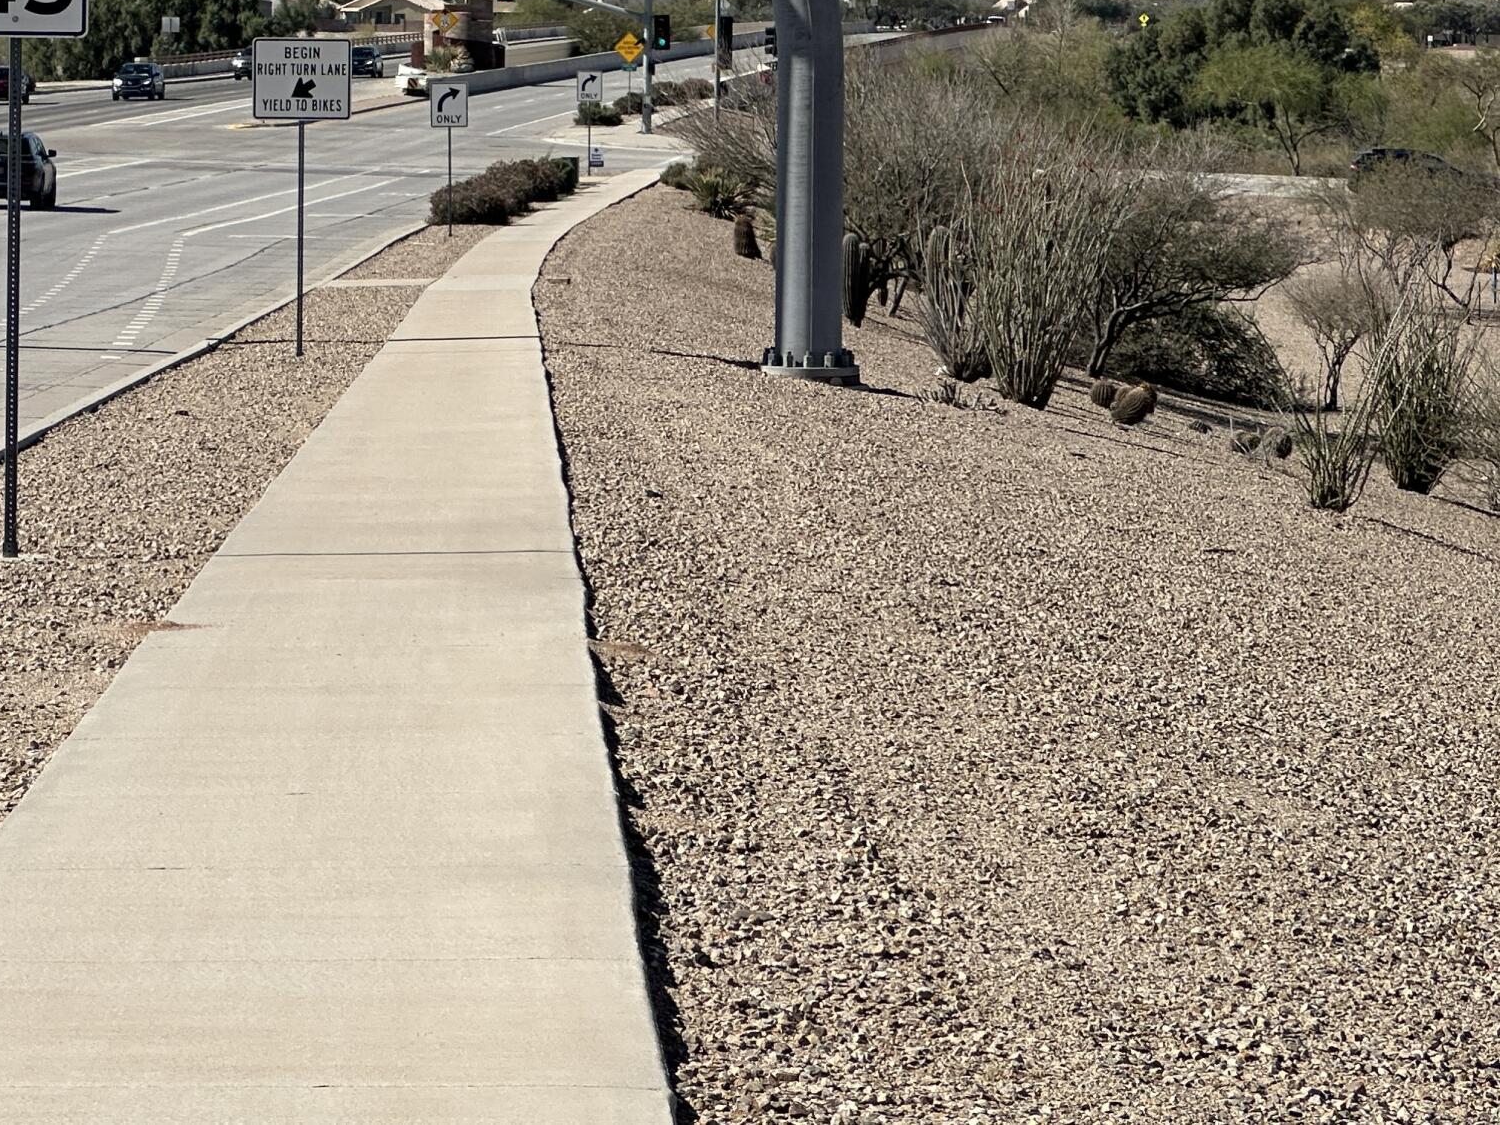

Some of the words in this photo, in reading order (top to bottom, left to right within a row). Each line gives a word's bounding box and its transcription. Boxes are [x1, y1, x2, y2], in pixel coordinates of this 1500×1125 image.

[284, 46, 321, 59] BEGIN
[257, 62, 287, 76] RIGHT
[290, 63, 317, 76] TURN
[321, 63, 347, 76] LANE
[262, 98, 292, 112] YIELD
[295, 98, 308, 112] TO
[311, 99, 342, 112] BIKES
[436, 114, 462, 124] ONLY
